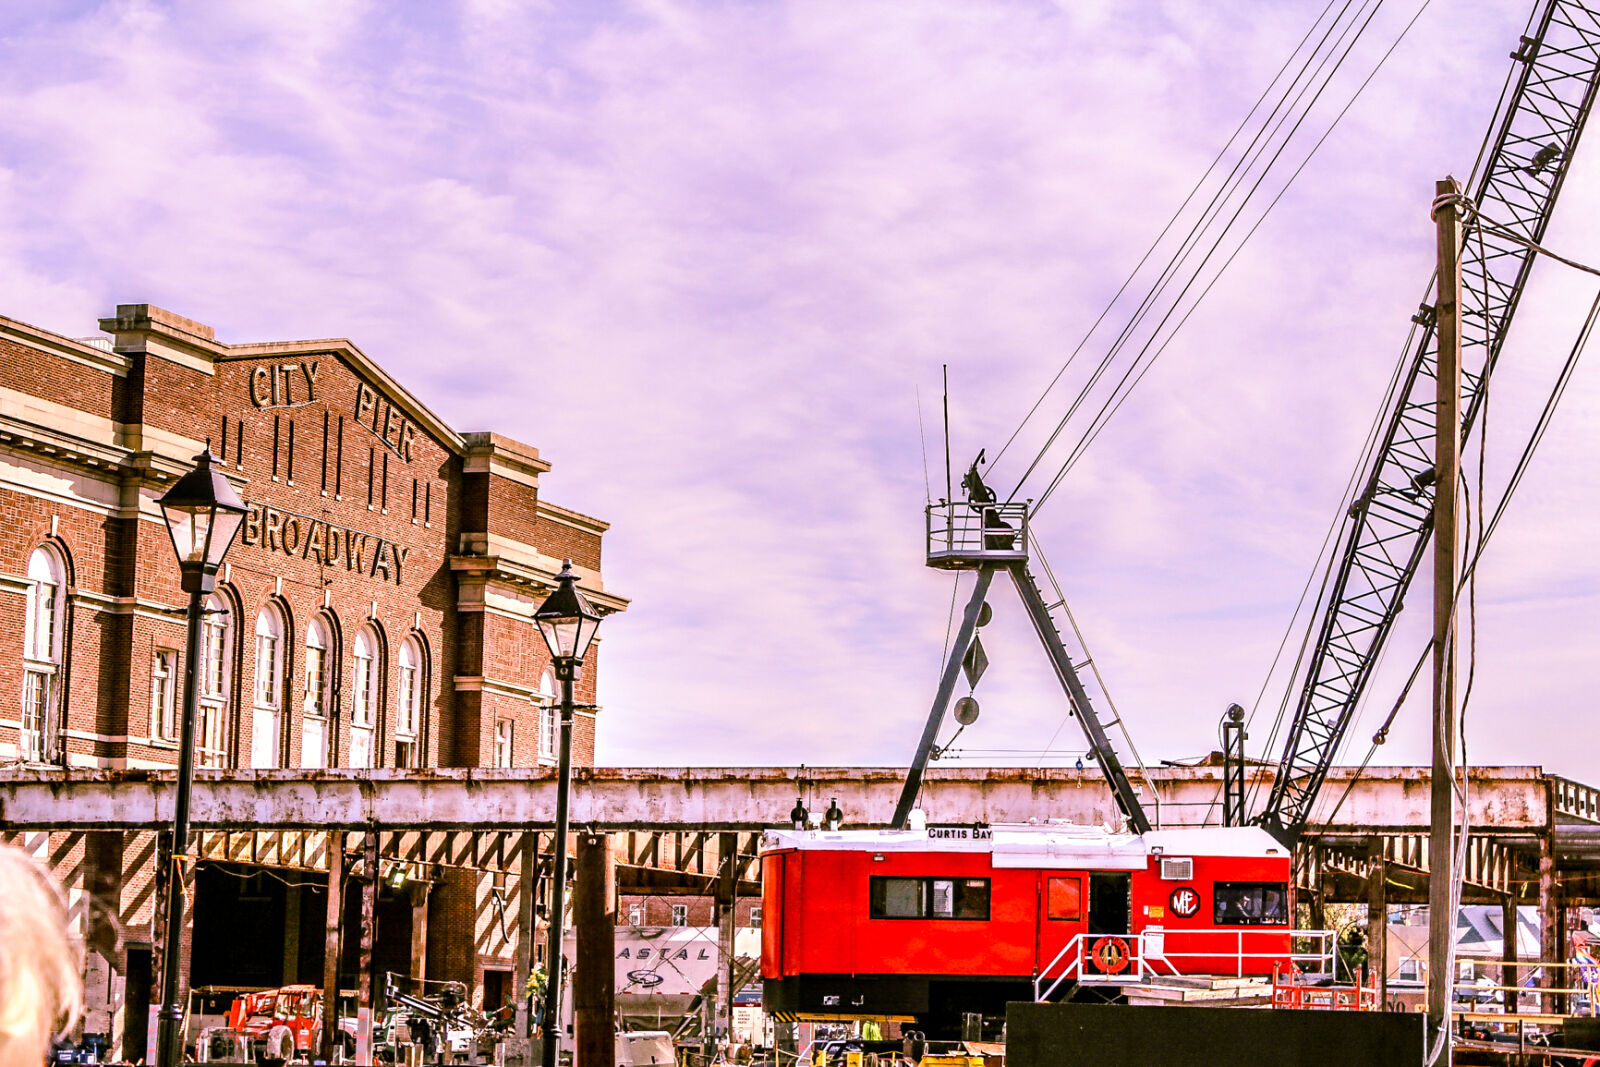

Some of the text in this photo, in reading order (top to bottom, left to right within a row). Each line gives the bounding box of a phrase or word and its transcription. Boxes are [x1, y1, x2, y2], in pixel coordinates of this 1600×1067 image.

[251, 361, 419, 464] CITY PIER
[242, 501, 409, 586] BROADWAY
[928, 828, 992, 839] CURTIS BAY
[615, 947, 709, 961] ASTAL
